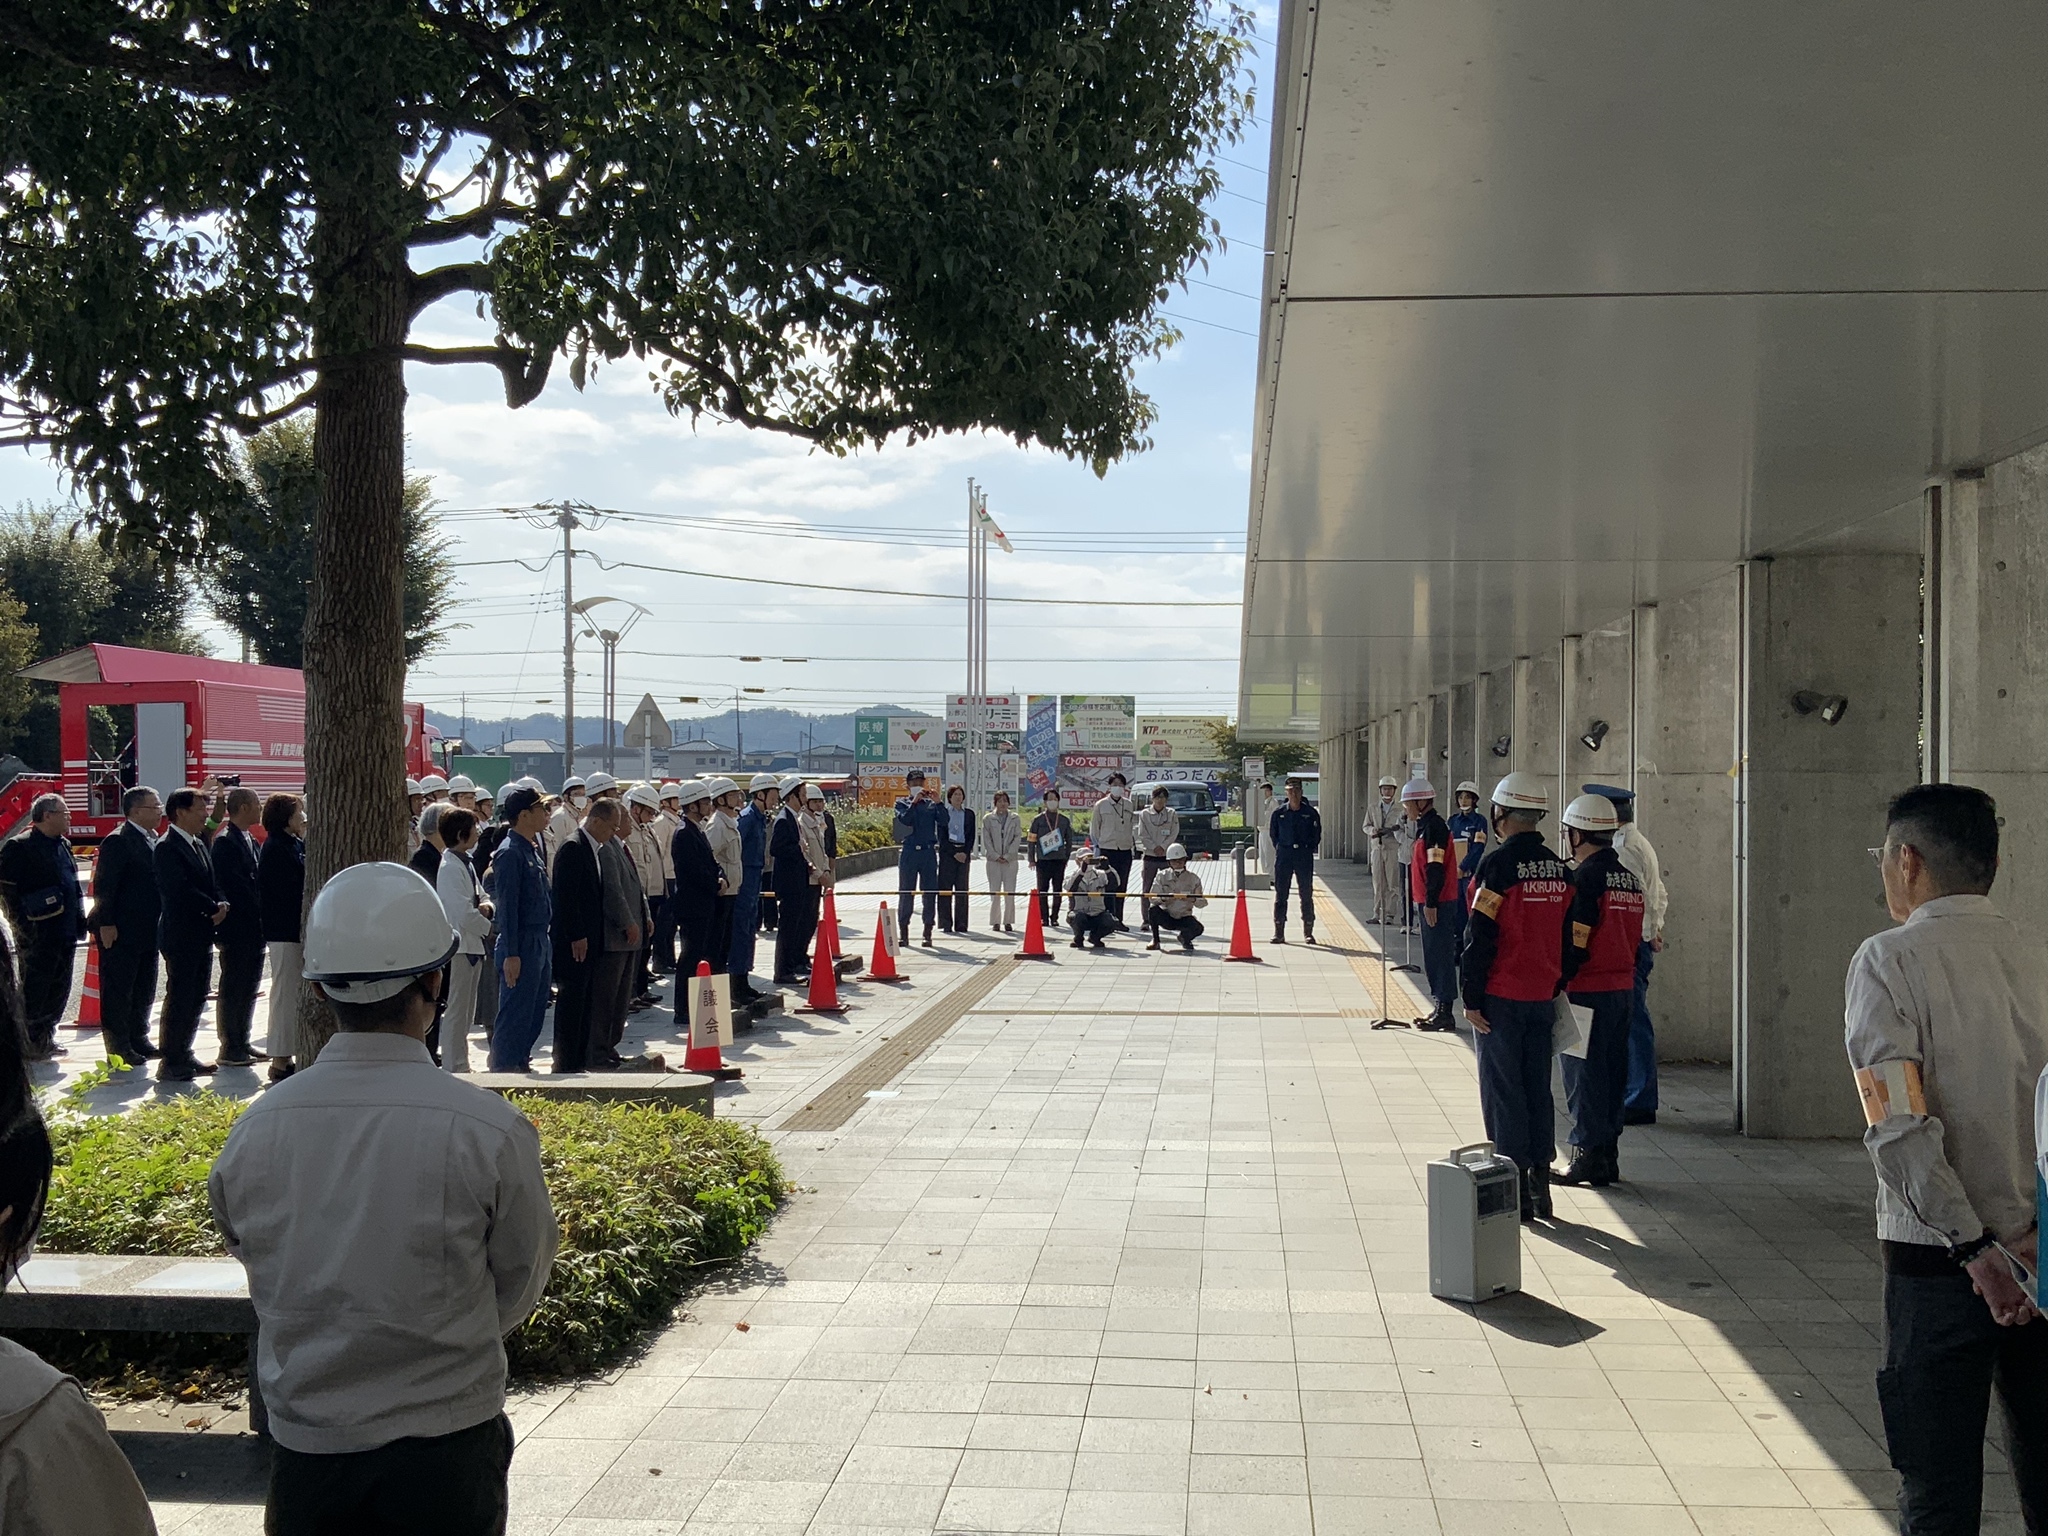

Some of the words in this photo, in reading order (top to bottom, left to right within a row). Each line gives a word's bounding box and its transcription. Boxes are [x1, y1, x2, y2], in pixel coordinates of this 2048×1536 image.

[859, 721, 884, 733] 医療
[867, 734, 876, 743] と
[1028, 727, 1055, 748] 雨の日
[270, 742, 282, 757] VR
[859, 744, 883, 756] 介護
[901, 744, 941, 752] 草花クリニック
[1064, 756, 1118, 767] ひので霊園
[1146, 769, 1218, 781] おぶつだん
[1516, 860, 1566, 879] あきる野市
[702, 989, 720, 1035] 議会
